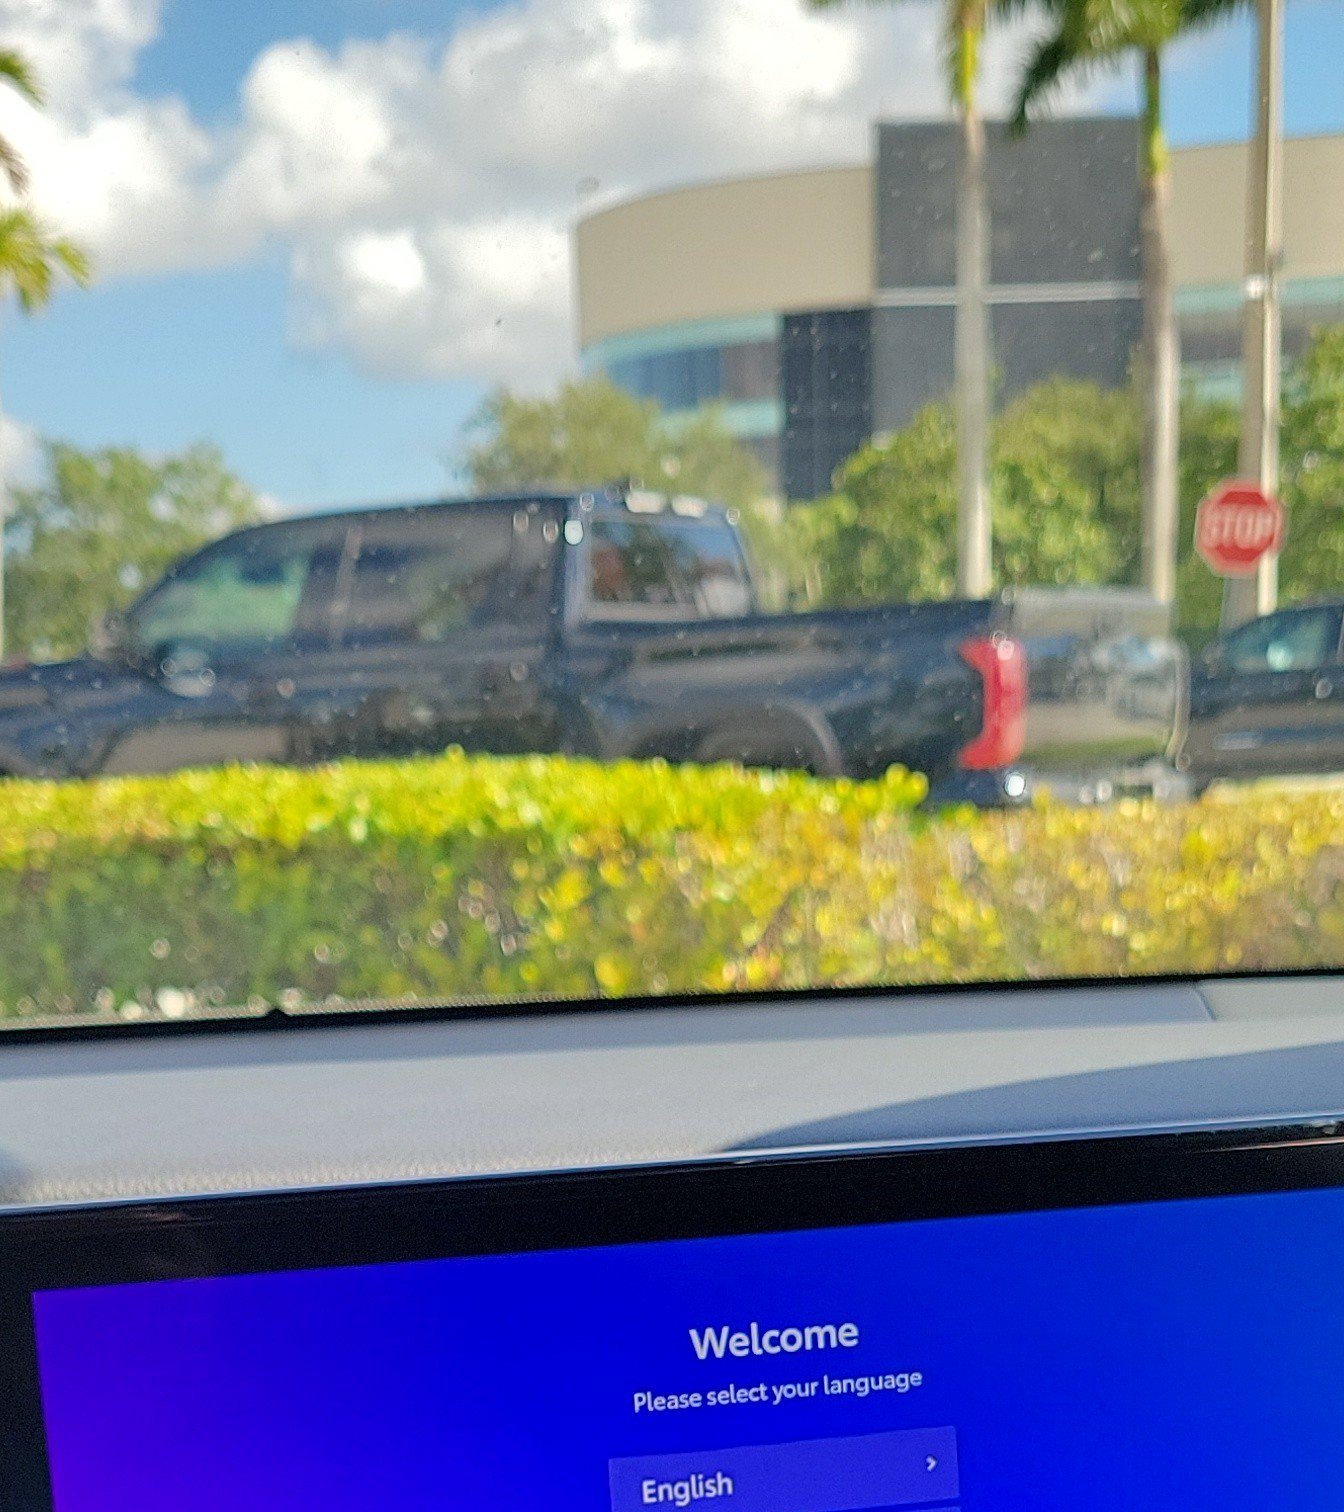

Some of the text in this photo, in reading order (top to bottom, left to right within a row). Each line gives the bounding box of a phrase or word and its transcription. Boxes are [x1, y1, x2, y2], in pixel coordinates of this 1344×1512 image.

[1199, 503, 1276, 548] STOP
[689, 1321, 860, 1360] Welcome
[633, 1369, 923, 1413] Please select your language
[641, 1471, 734, 1507] English
